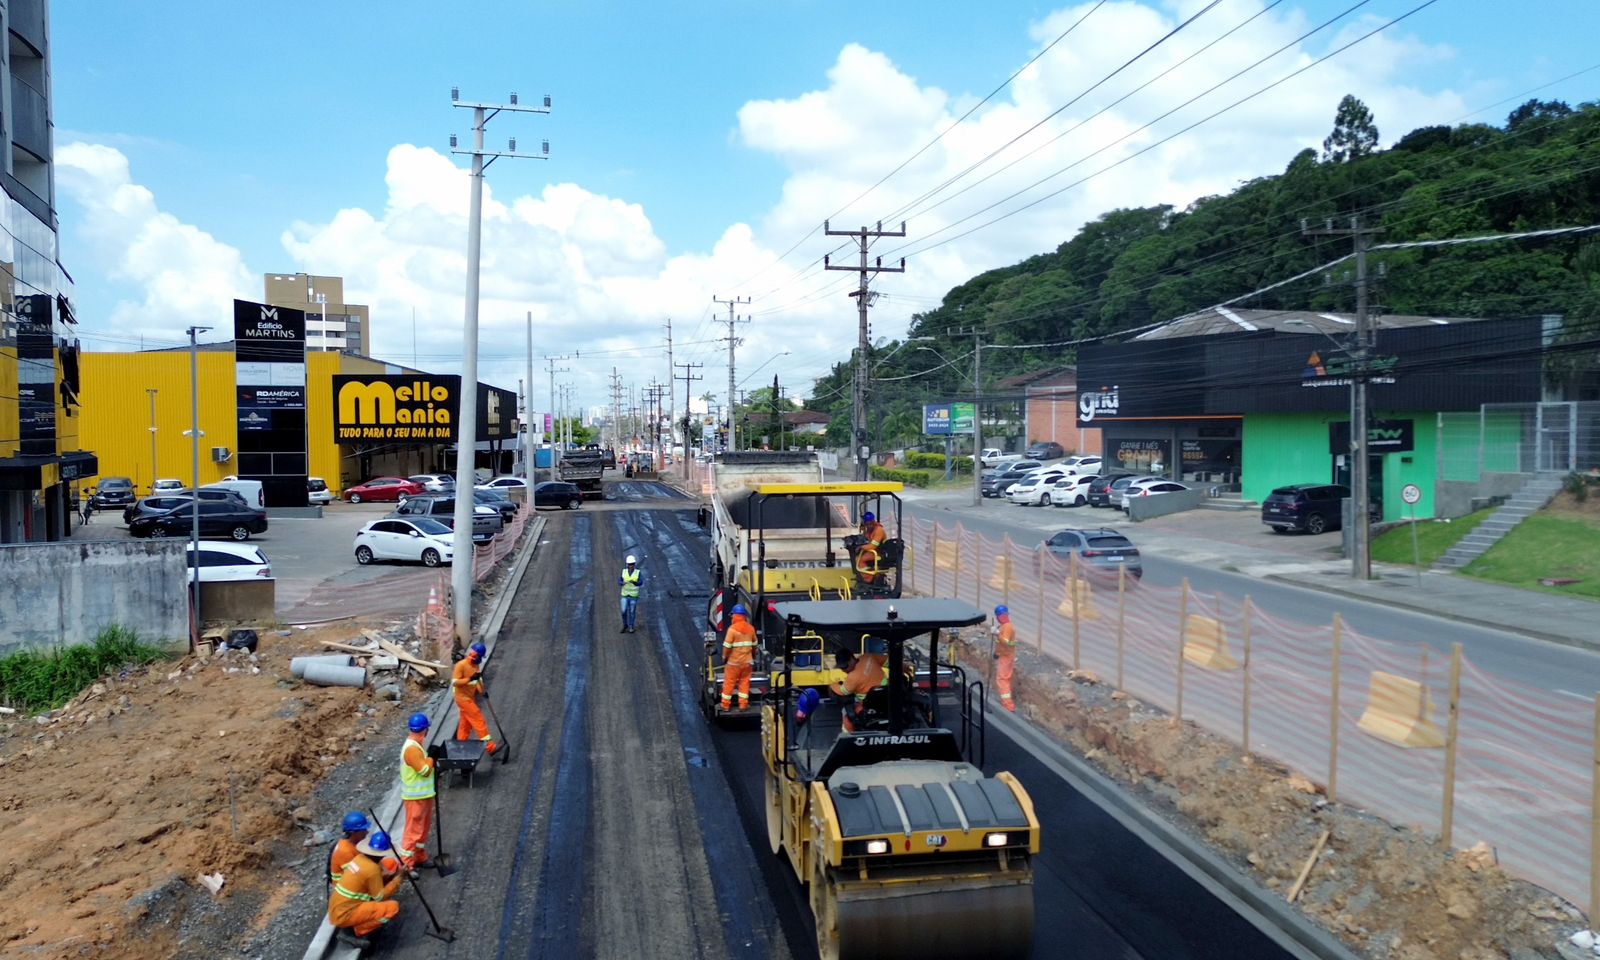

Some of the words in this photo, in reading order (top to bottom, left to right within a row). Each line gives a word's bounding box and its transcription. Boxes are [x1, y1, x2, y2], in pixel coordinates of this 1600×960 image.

[245, 329, 296, 339] MARTINS
[1079, 385, 1119, 422] grid
[339, 427, 361, 438] TUDO
[362, 427, 385, 439] PARA
[386, 427, 393, 438] O
[393, 427, 410, 438] SEU
[411, 427, 427, 438] DIA
[427, 427, 434, 438] A
[435, 427, 451, 438] DIA
[868, 735, 931, 746] INFRASUL
